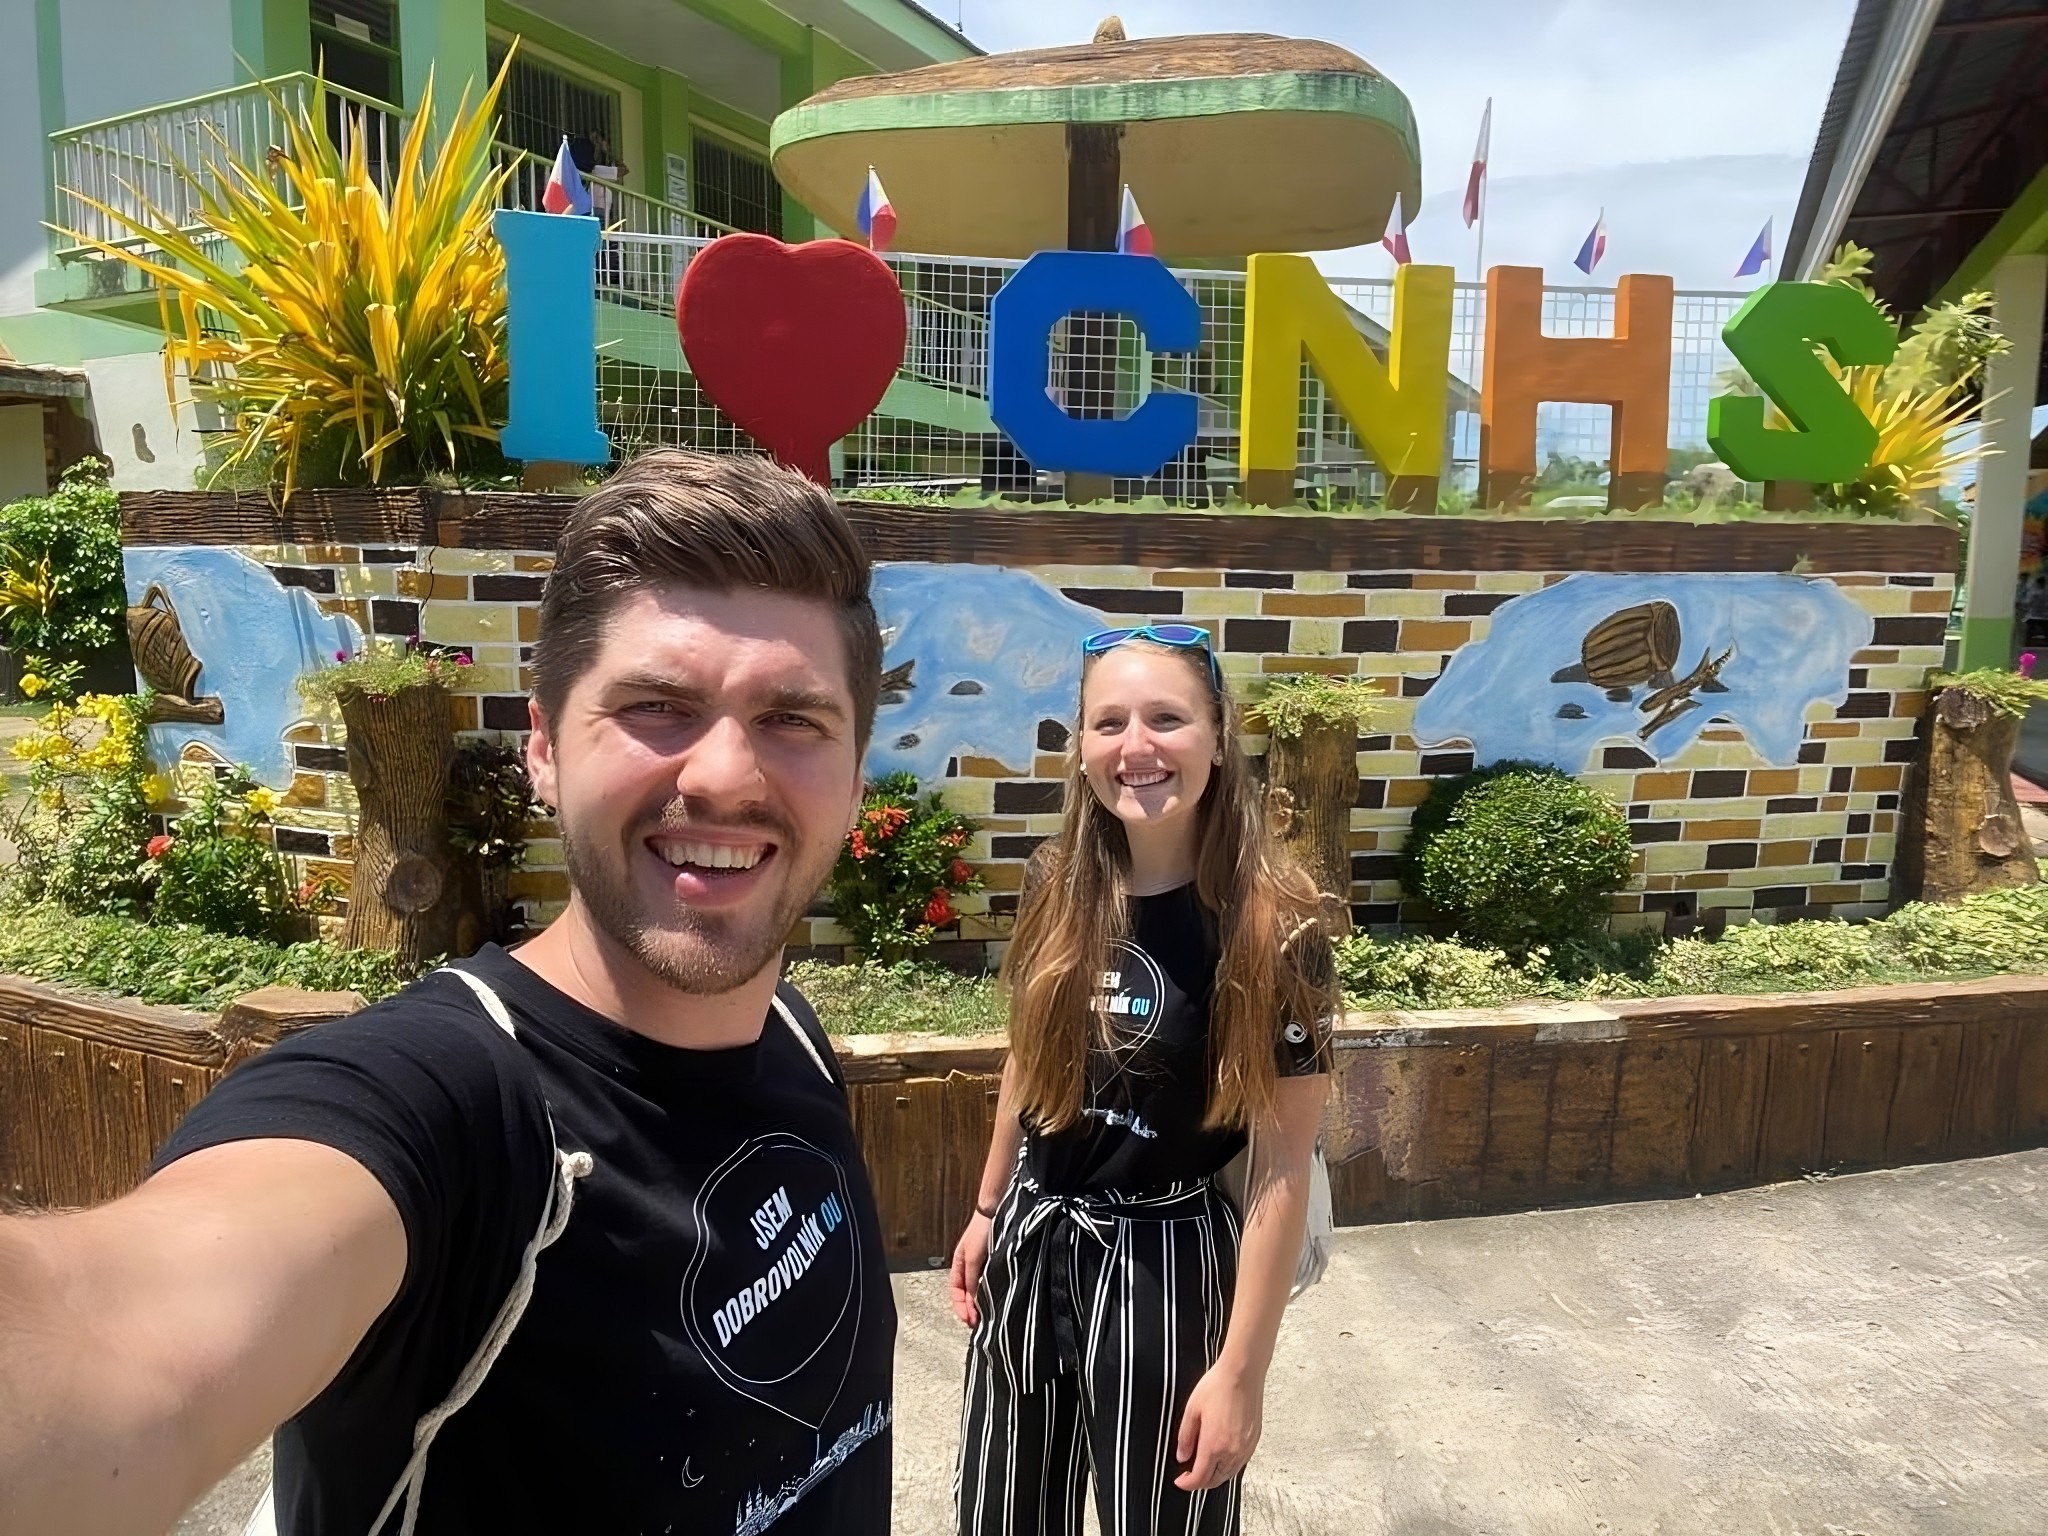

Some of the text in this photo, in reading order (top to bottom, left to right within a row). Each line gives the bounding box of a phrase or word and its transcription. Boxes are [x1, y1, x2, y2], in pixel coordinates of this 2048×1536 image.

[492, 208, 1899, 483] I CNHS
[1131, 997, 1151, 1016] OU
[712, 1191, 843, 1348] DOBROVOLNÍK OU
[749, 1186, 793, 1251] JSEM
